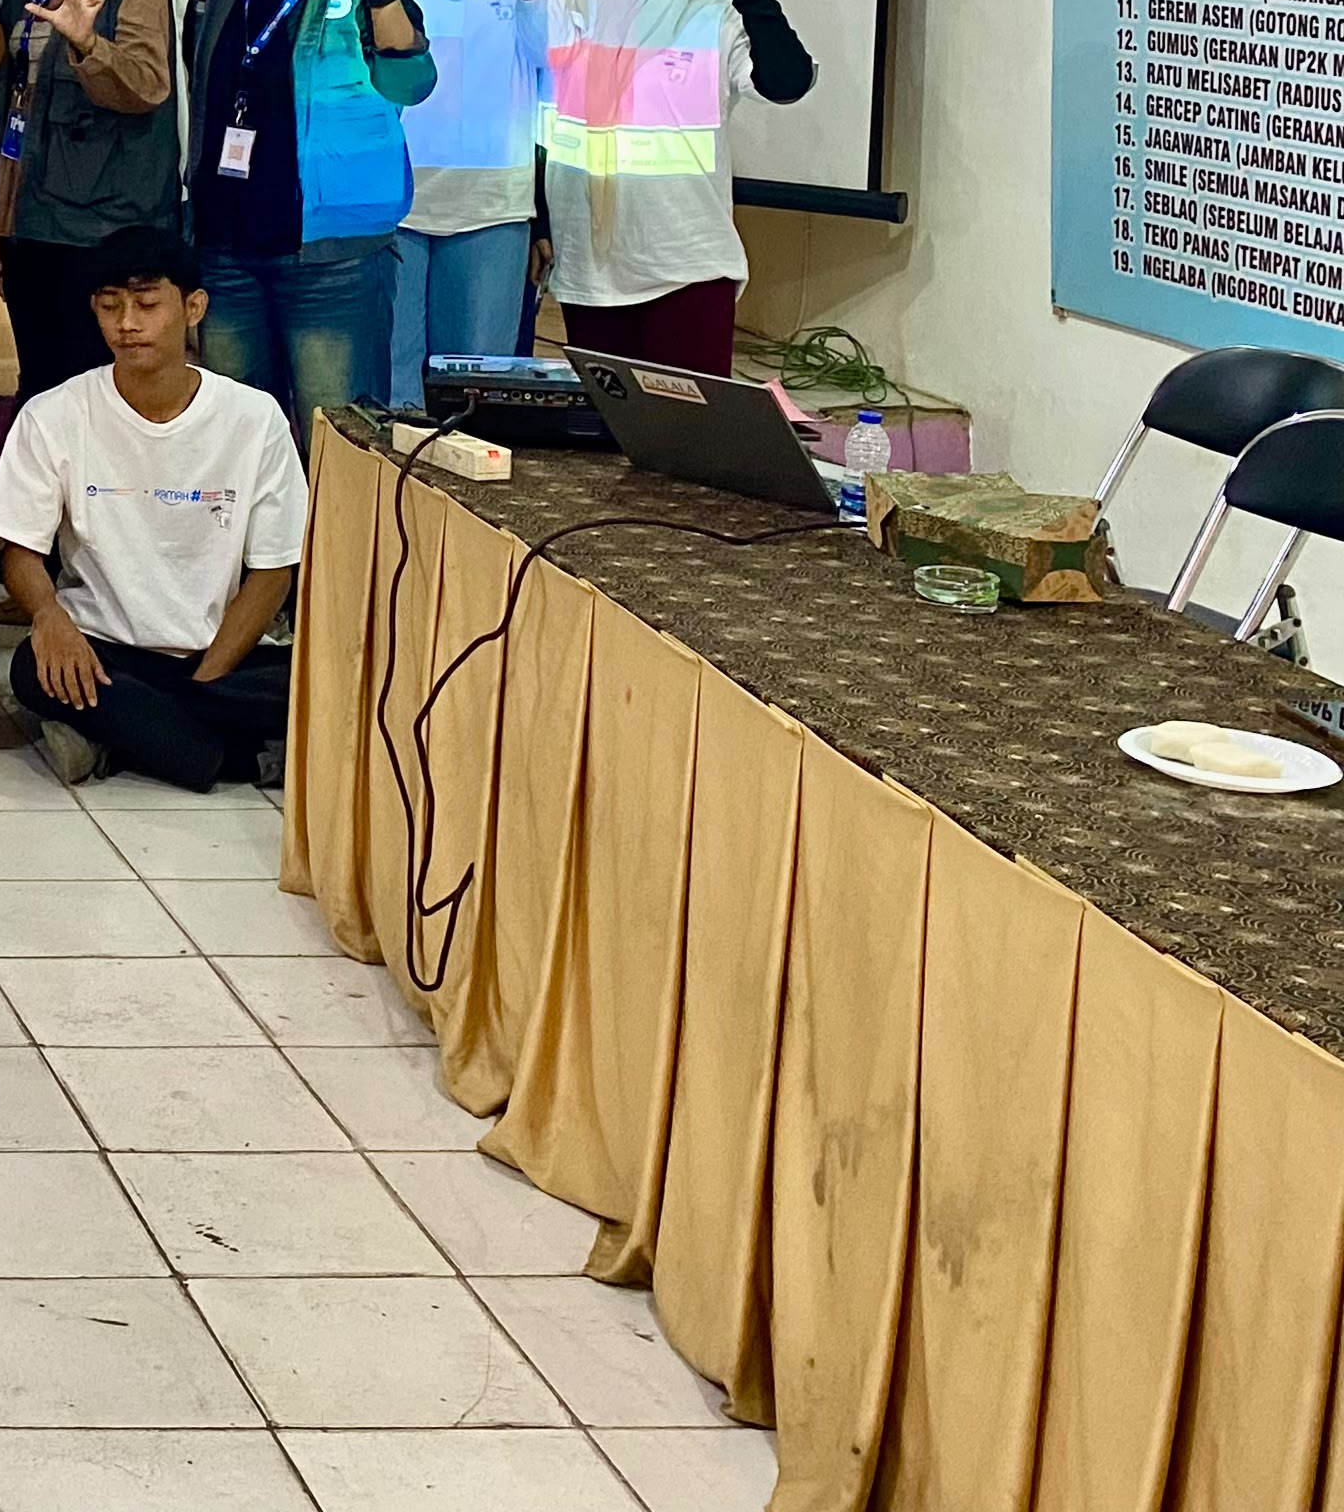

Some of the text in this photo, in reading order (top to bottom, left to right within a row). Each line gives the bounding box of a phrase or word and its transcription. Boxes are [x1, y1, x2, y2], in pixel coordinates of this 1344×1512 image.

[1202, 2, 1243, 30] ASEM
[1250, 9, 1320, 39] (GOTONG
[1117, 29, 1137, 52] 12.
[1147, 30, 1199, 58] GUMUS
[1203, 37, 1279, 68] (GERAKAN
[1285, 47, 1328, 75] UP2K
[1115, 92, 1136, 115] 14.
[1146, 95, 1201, 123] GERCEP
[1207, 105, 1260, 134] CATING
[1116, 60, 1342, 112] 13. RATU MELISABET (RADIUS
[1115, 124, 1344, 185] 15. JAGAWARTA (JAMBAN KEL
[1114, 156, 1135, 179] 16.
[1144, 159, 1188, 188] SMILE
[1192, 168, 1249, 200] (SEMUA
[1255, 180, 1331, 217] MASAKAN
[1114, 187, 1135, 211] 17.
[1144, 190, 1197, 225] SEBLAQ
[1203, 203, 1278, 241] (SEBELUM
[1112, 249, 1134, 274] 19.
[1143, 254, 1207, 290] NGELABA
[1211, 272, 1288, 312] (NGOBROL
[1113, 219, 1343, 291] 18. TEKO PANAS (TEMPAT KOM
